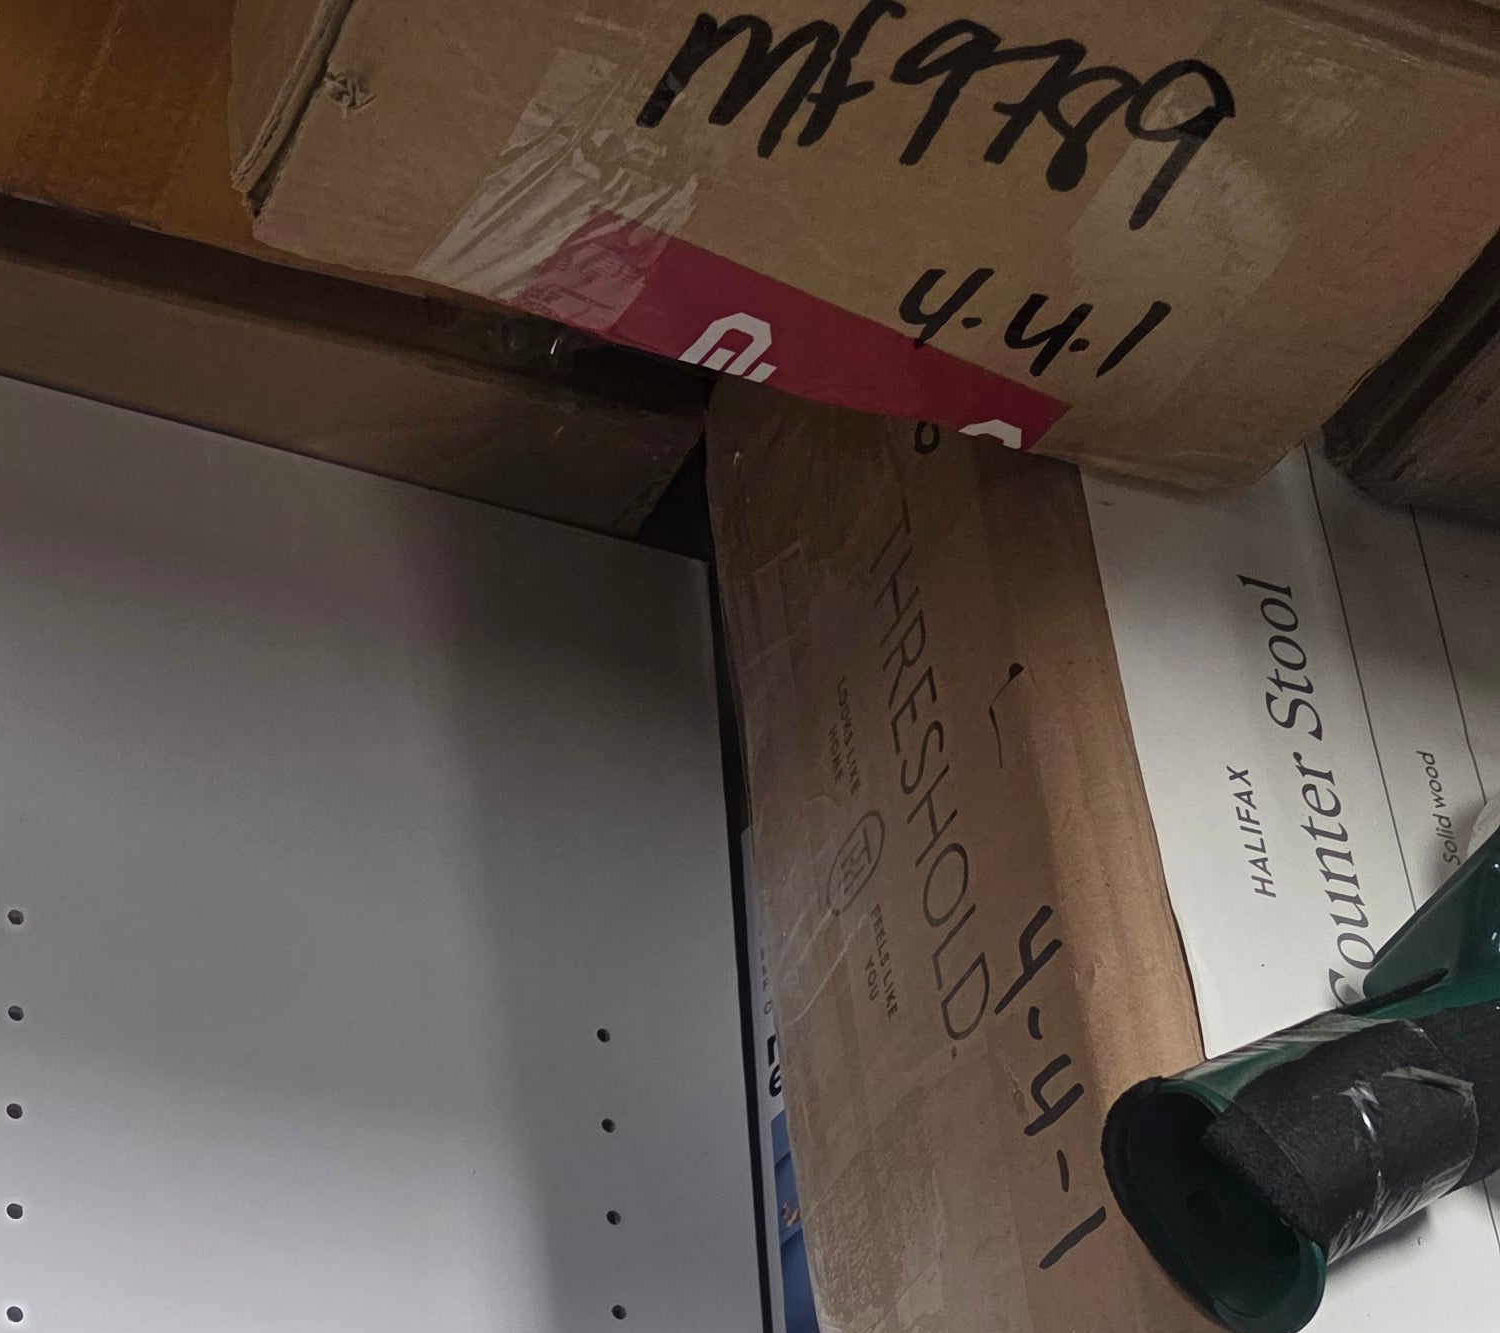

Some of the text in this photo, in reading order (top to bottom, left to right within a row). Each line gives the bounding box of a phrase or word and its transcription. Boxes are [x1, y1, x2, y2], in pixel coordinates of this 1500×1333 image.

[1236, 574, 1323, 741] Stool
[869, 497, 990, 1041] THRESHOLD
[1416, 751, 1461, 866] Solid wood
[1226, 765, 1277, 898] HALIFAX
[864, 955, 879, 1001] YOU
[870, 903, 899, 1019] FEELS LIKE
